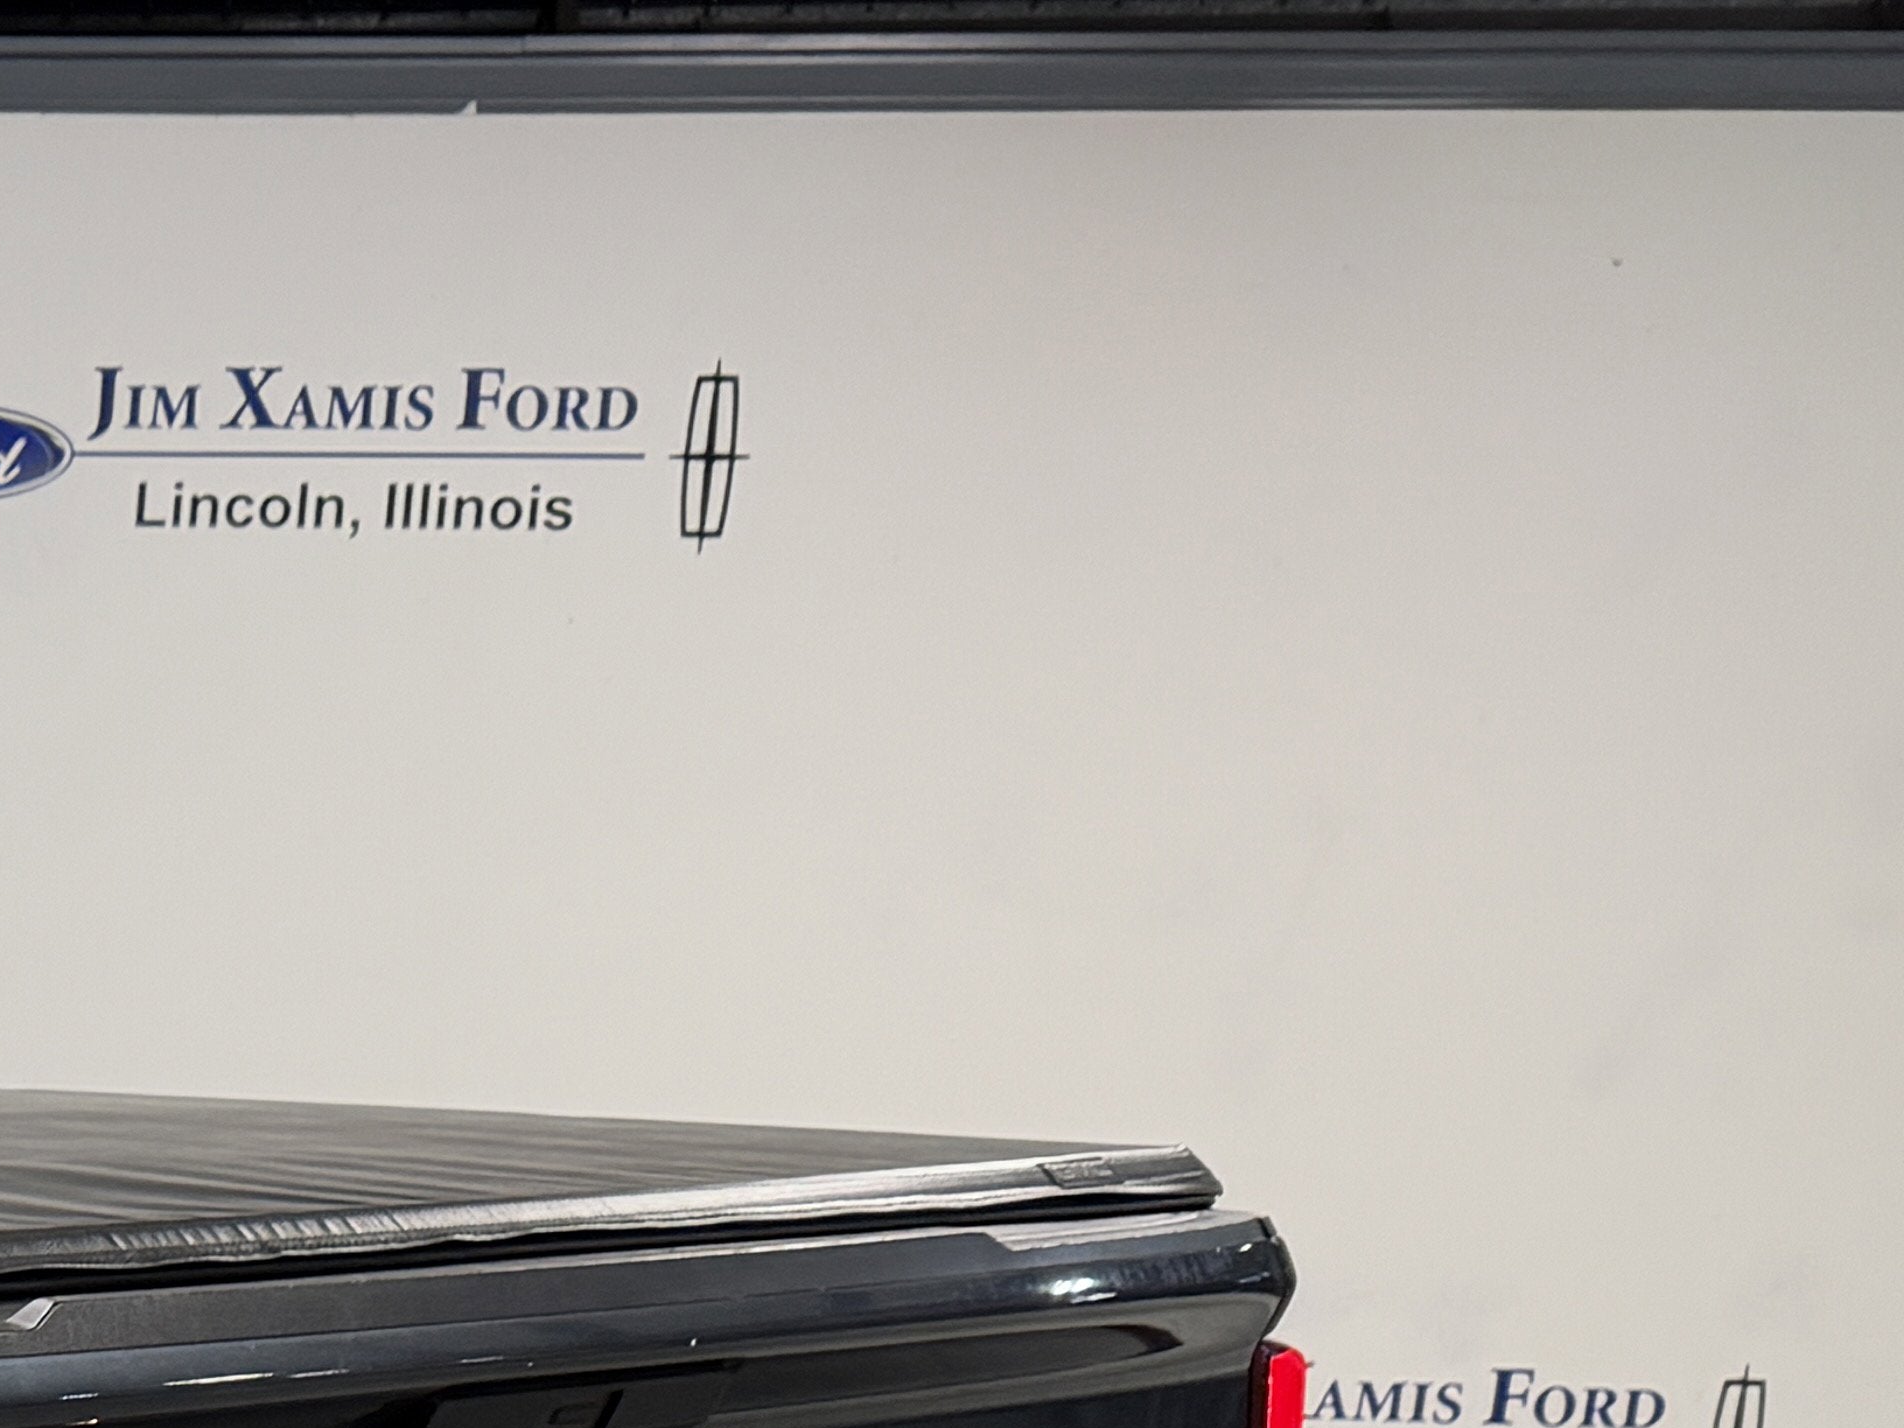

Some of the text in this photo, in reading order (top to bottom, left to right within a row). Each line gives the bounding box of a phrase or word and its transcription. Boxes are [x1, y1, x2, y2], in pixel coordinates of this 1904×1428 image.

[86, 365, 639, 442] JIM XAMIS FORD
[134, 481, 575, 538] Lincoln, Illinois
[1303, 1362, 1464, 1425] AMIS
